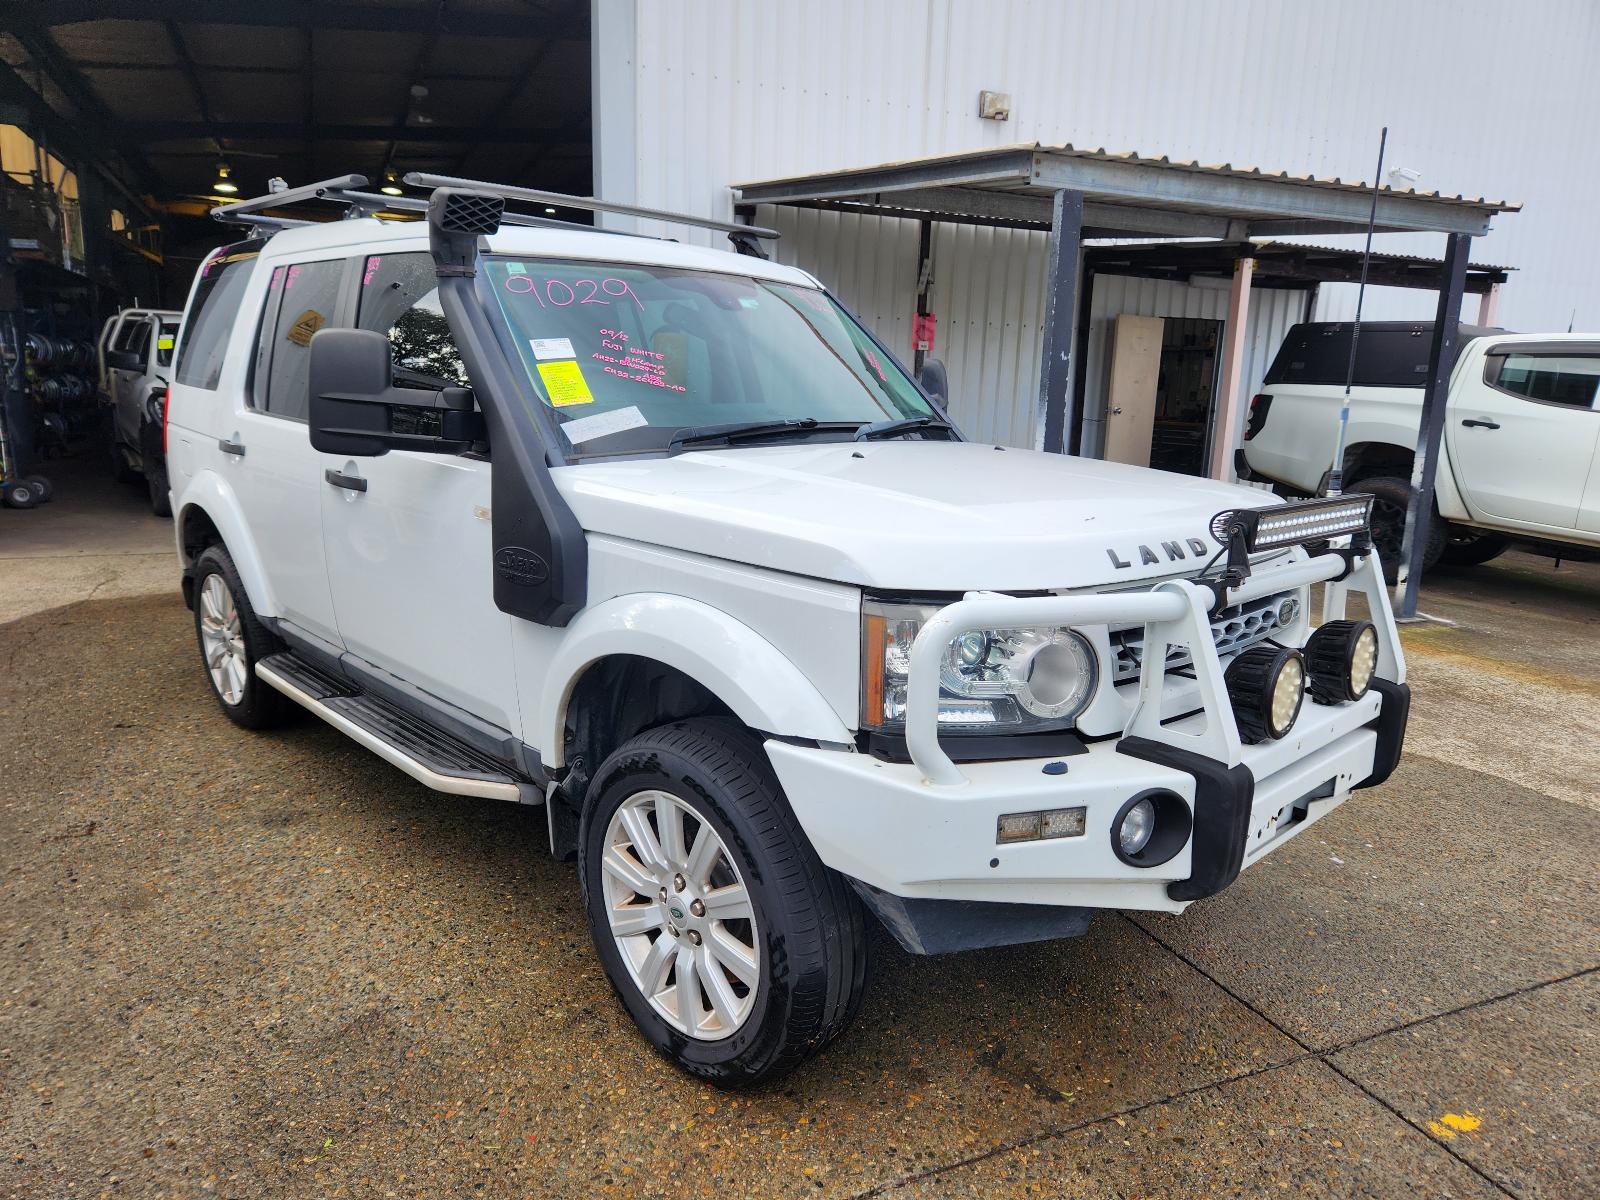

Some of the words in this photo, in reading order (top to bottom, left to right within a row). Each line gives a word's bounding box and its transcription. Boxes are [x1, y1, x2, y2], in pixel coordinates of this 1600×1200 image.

[505, 276, 644, 311] 9029
[600, 328, 629, 342] 09/12
[602, 340, 623, 351] FUJI
[630, 347, 665, 360] WHITE
[1106, 537, 1208, 569] LAND
